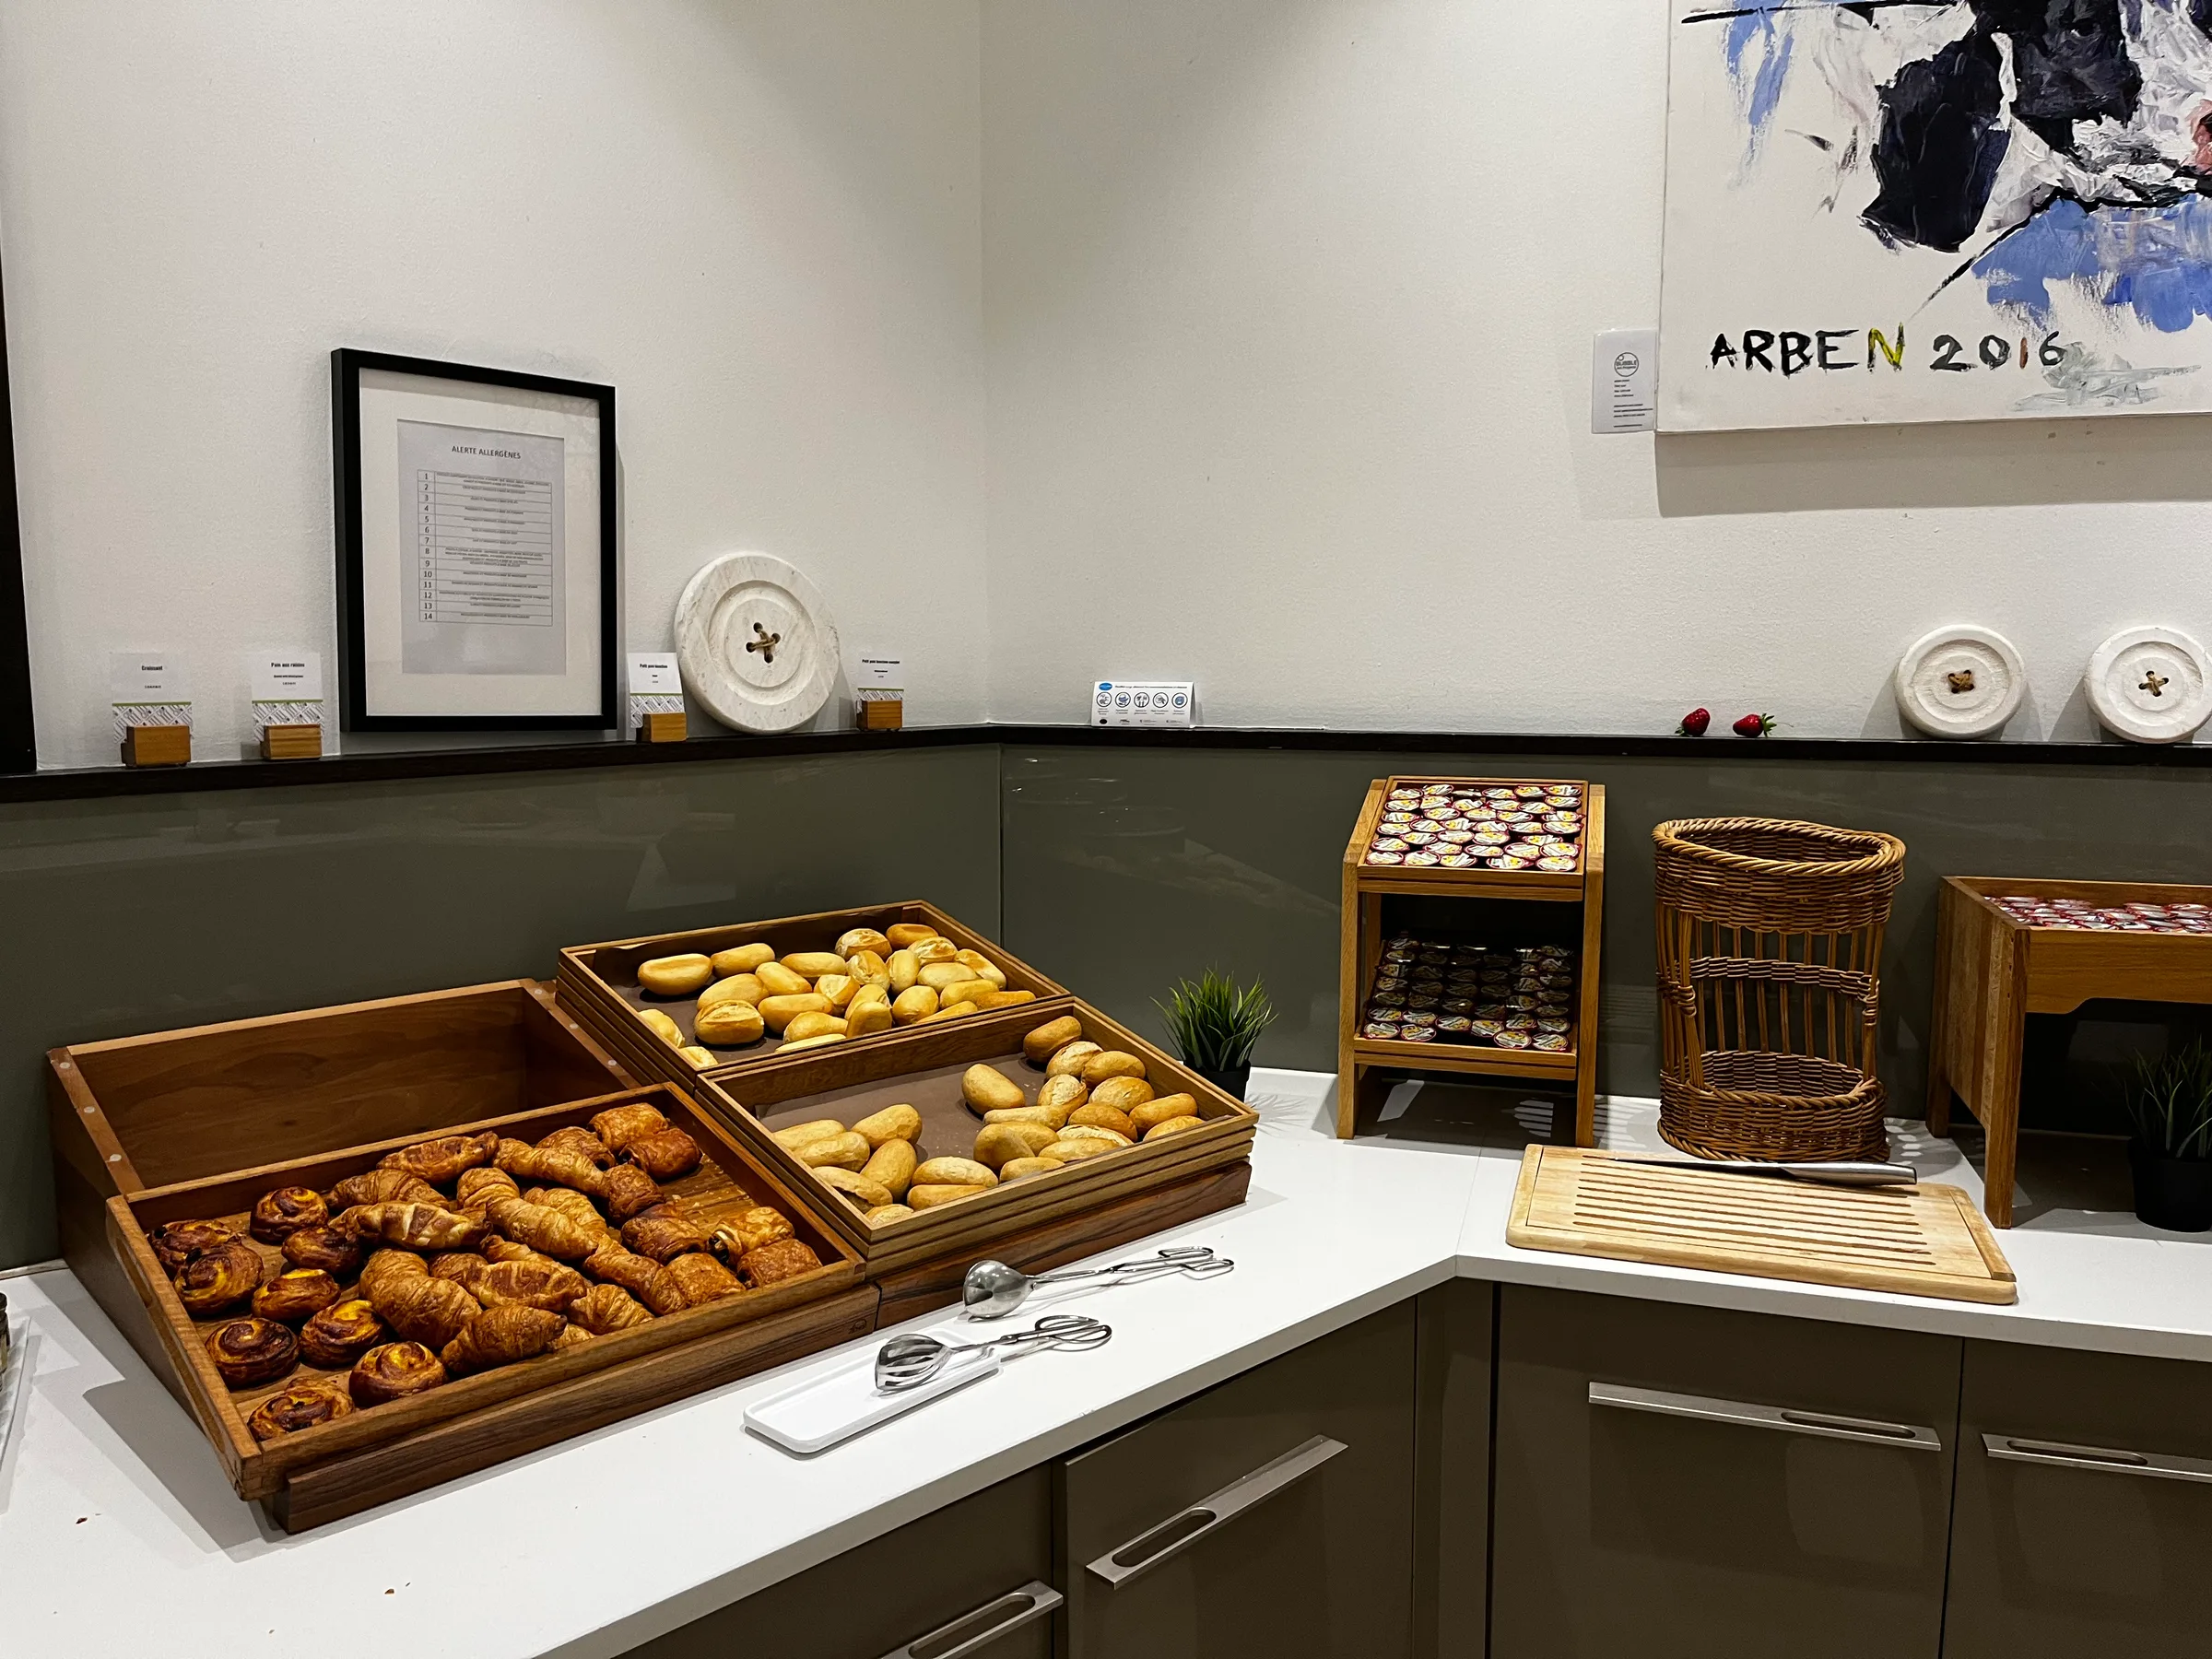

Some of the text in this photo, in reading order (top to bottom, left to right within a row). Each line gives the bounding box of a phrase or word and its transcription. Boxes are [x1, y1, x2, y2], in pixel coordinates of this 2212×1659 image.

[1710, 322, 2067, 379] ARBEN 2016
[452, 445, 477, 454] ALERTE
